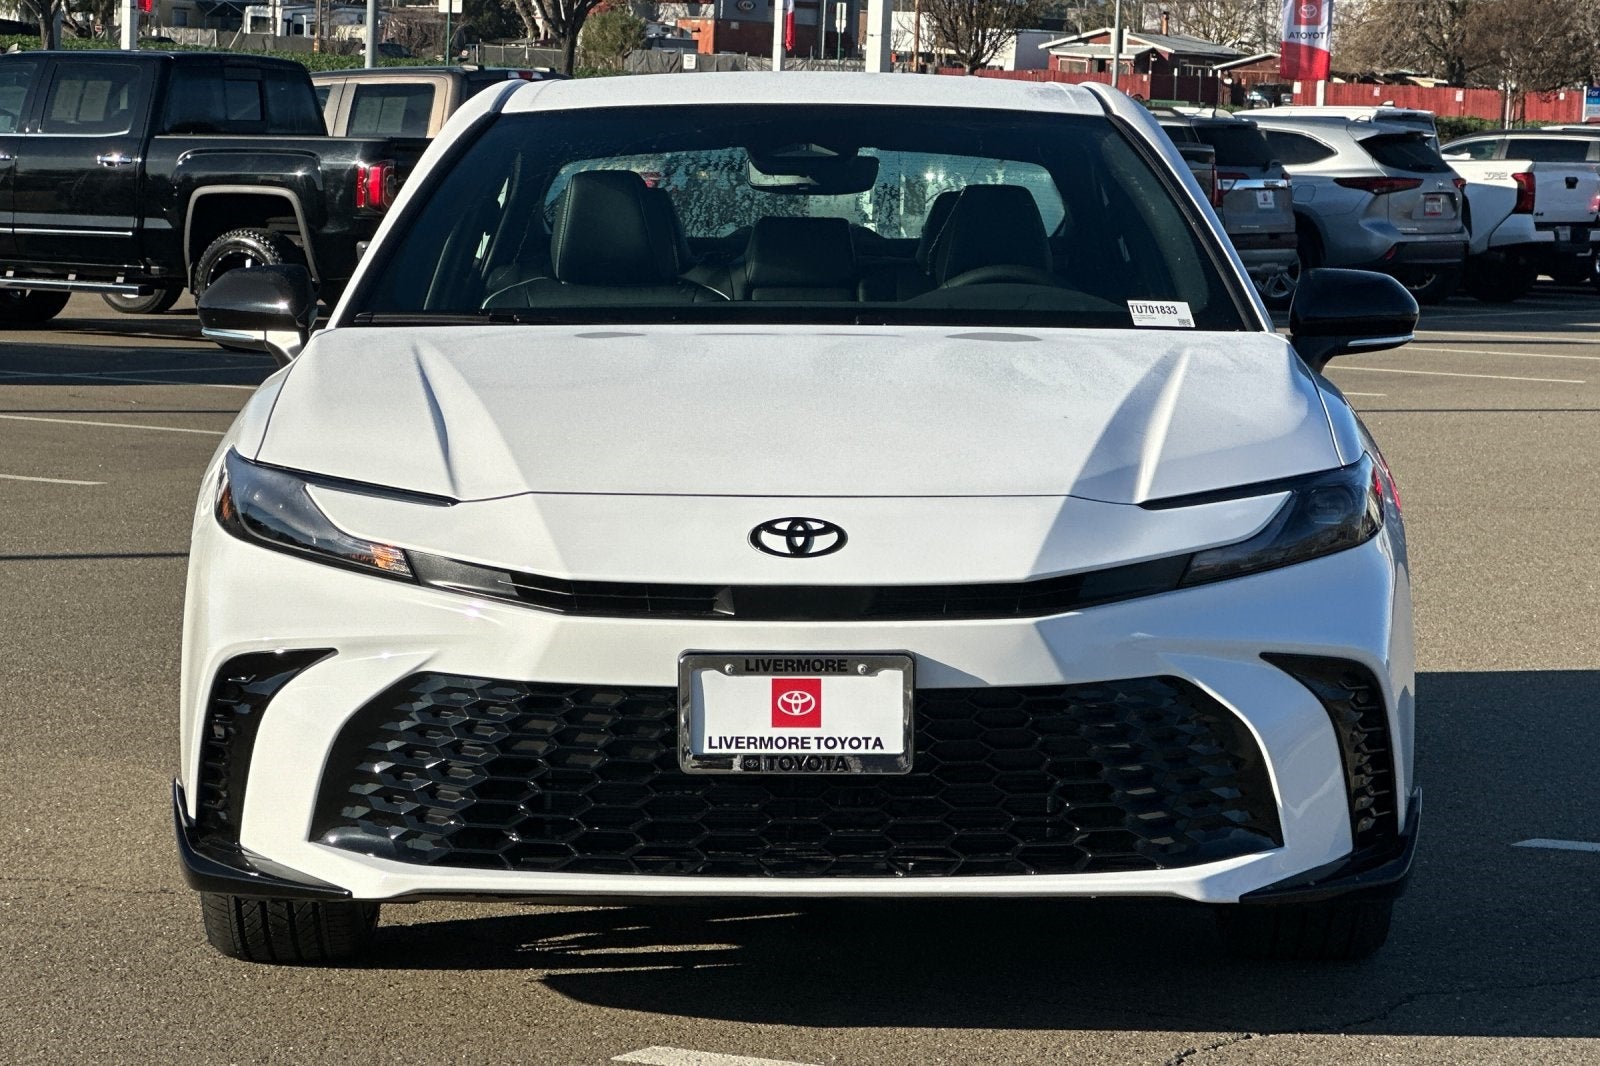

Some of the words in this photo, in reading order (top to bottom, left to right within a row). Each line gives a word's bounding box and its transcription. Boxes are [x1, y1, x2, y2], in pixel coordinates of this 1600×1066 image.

[1130, 304, 1178, 315] TU701833
[745, 658, 848, 672] LIVERMORE
[708, 736, 811, 750] LIVERMORE
[814, 736, 885, 750] TOYOTA
[767, 755, 849, 772] TOYOTA
